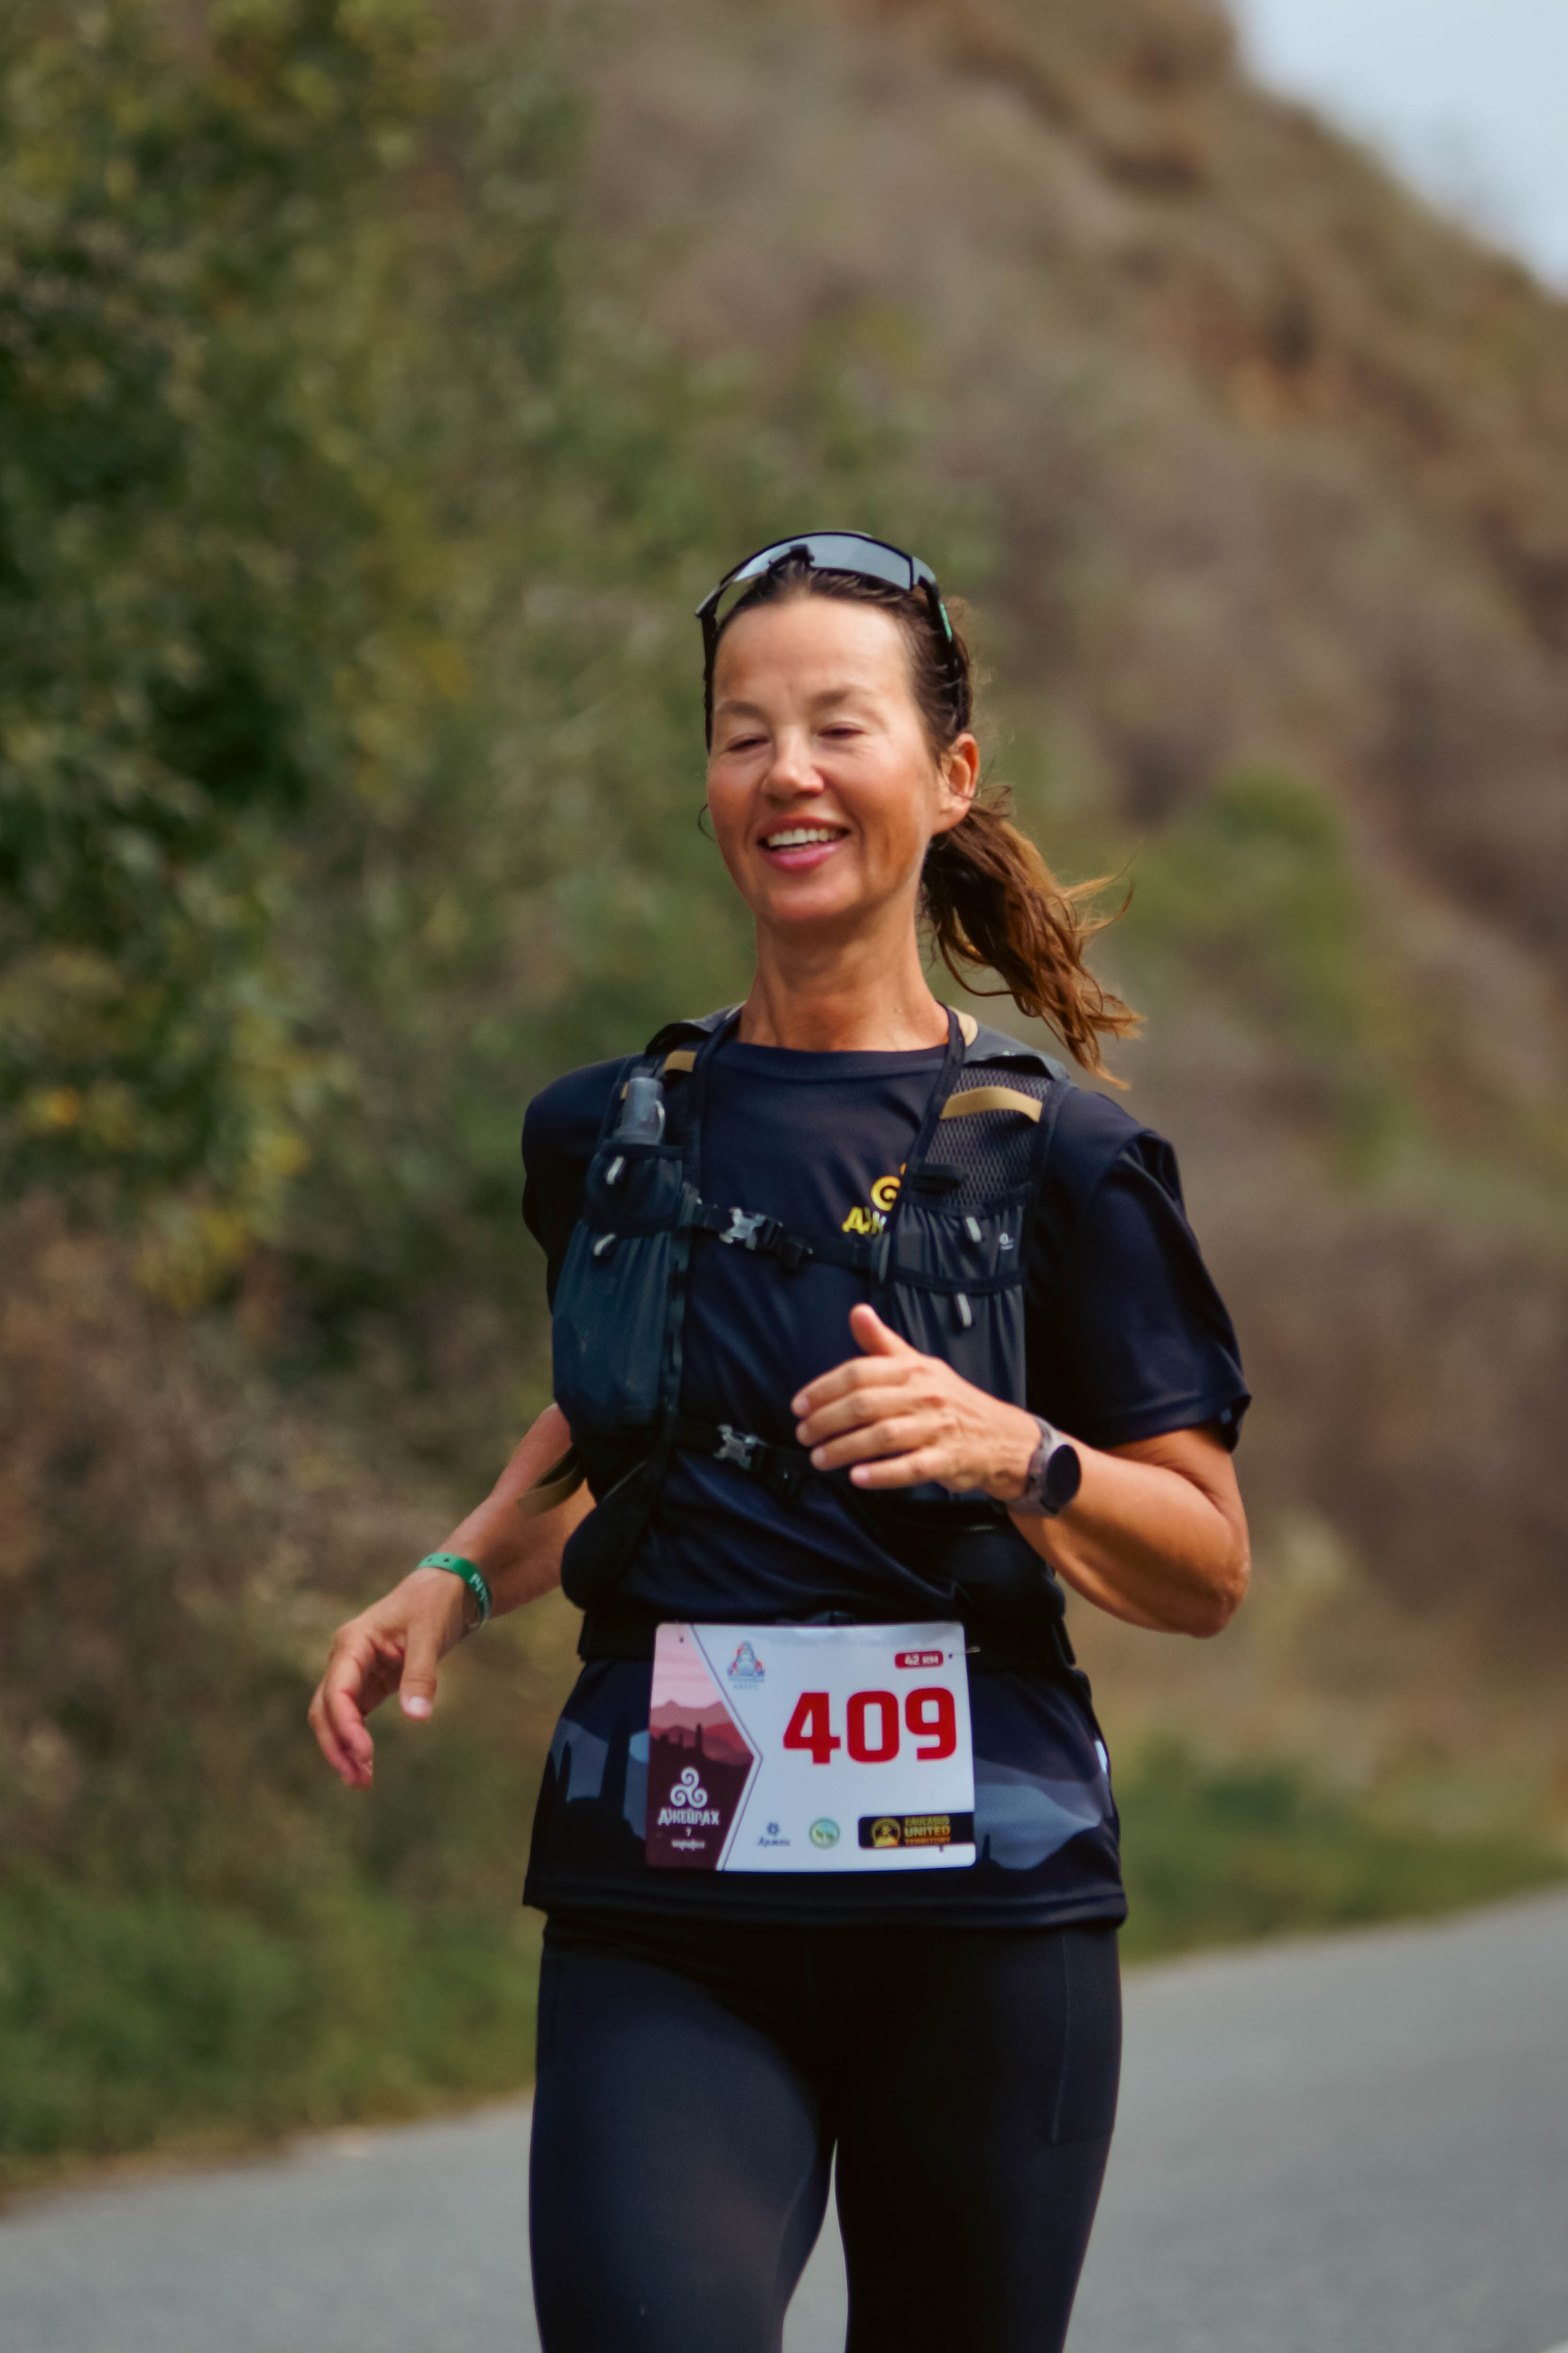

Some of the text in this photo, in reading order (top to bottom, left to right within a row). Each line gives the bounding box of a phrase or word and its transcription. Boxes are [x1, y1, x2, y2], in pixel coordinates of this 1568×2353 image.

[905, 1653, 919, 1666] 42
[783, 1688, 957, 1764] 409
[658, 1808, 719, 1826] ДЖЕЙРАХ
[904, 1825, 951, 1837] UNITED
